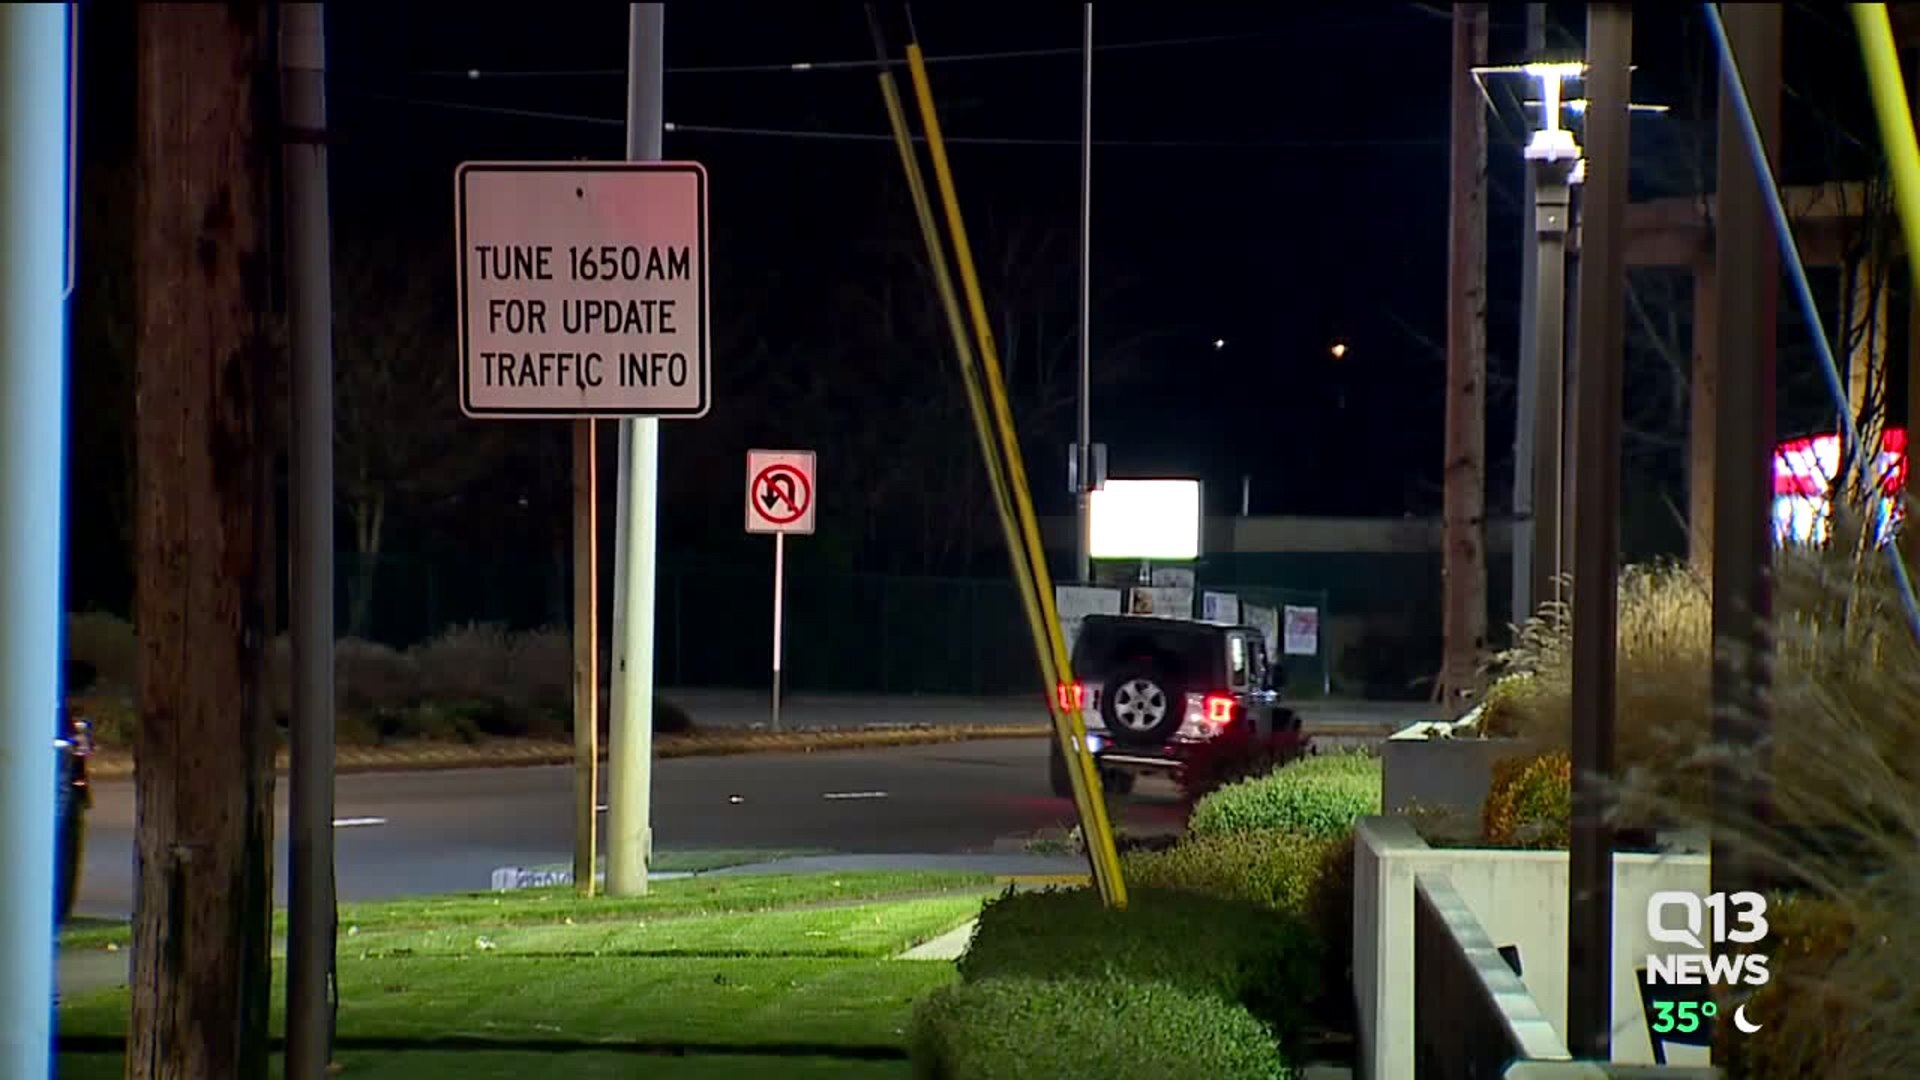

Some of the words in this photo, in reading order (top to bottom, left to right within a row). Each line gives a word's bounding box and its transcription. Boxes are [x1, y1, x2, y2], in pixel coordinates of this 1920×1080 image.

[475, 246, 553, 280] TUNE
[489, 300, 546, 334] FOR
[562, 300, 676, 334] UPDATE
[480, 352, 602, 387] TRAFFIC
[619, 352, 687, 387] INFO
